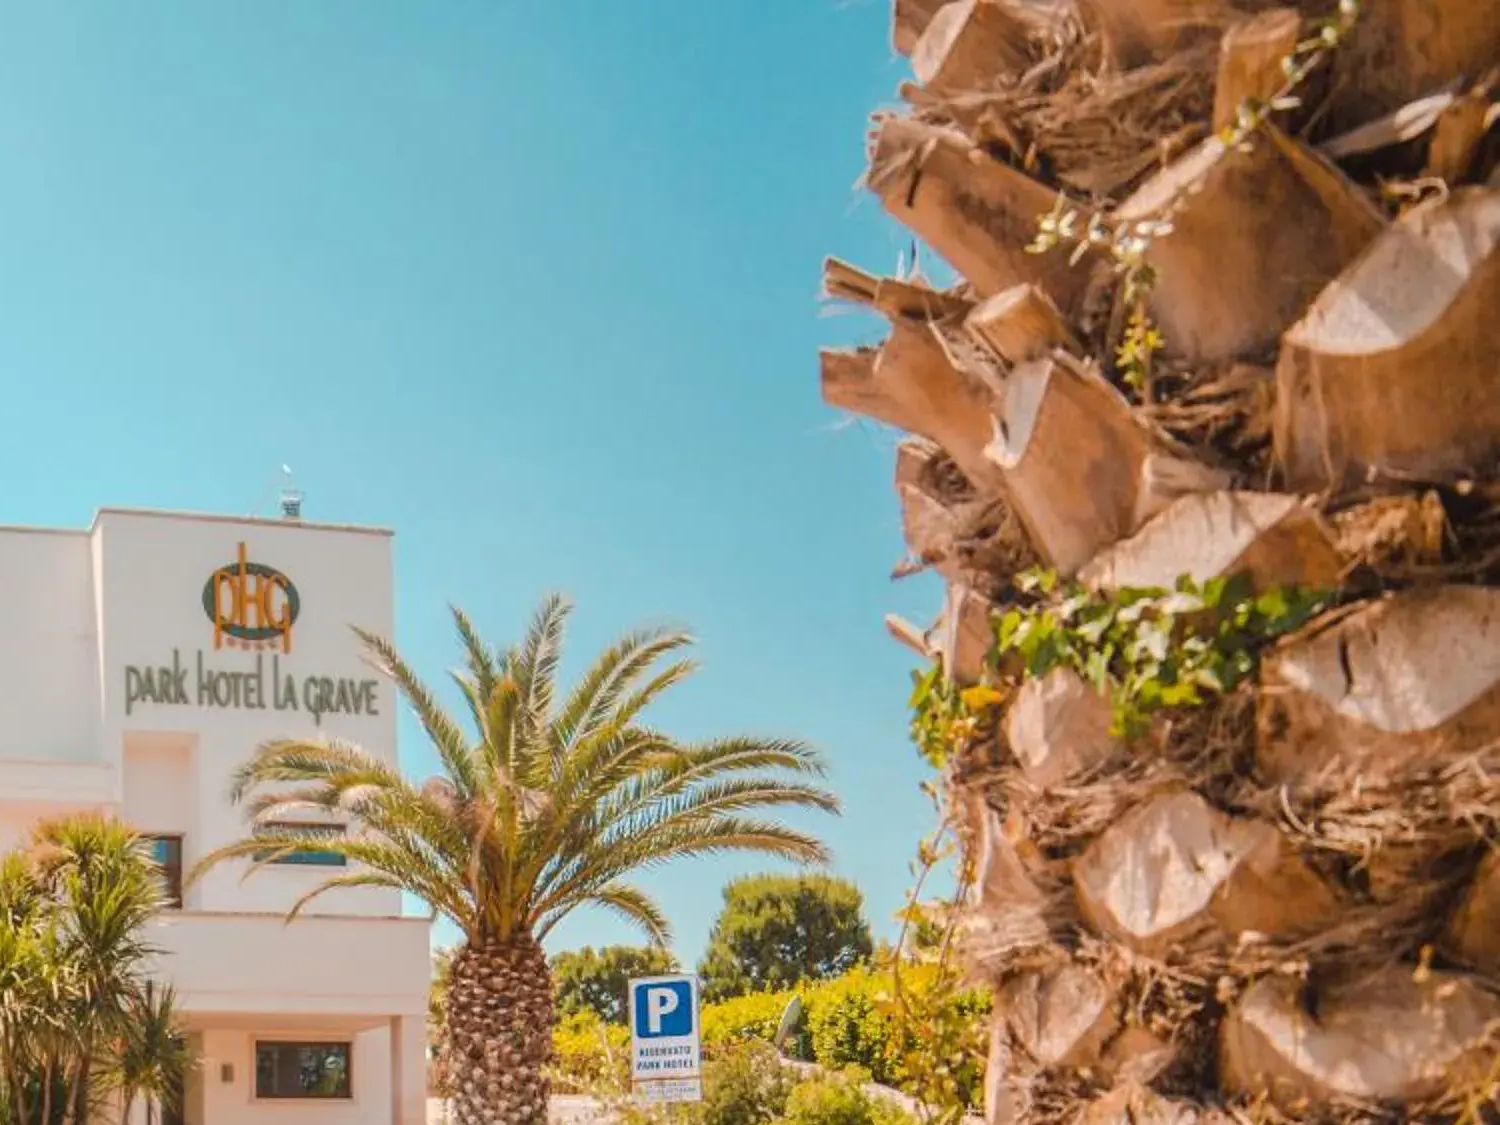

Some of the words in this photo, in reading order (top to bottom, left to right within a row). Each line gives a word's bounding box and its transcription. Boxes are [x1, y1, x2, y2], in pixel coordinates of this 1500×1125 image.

[124, 648, 189, 716] PARK
[197, 648, 266, 710] HOTEL
[303, 675, 380, 726] GRAVE
[647, 987, 679, 1033] P
[636, 1060, 661, 1071] PARK
[663, 1059, 694, 1069] HOTEL
